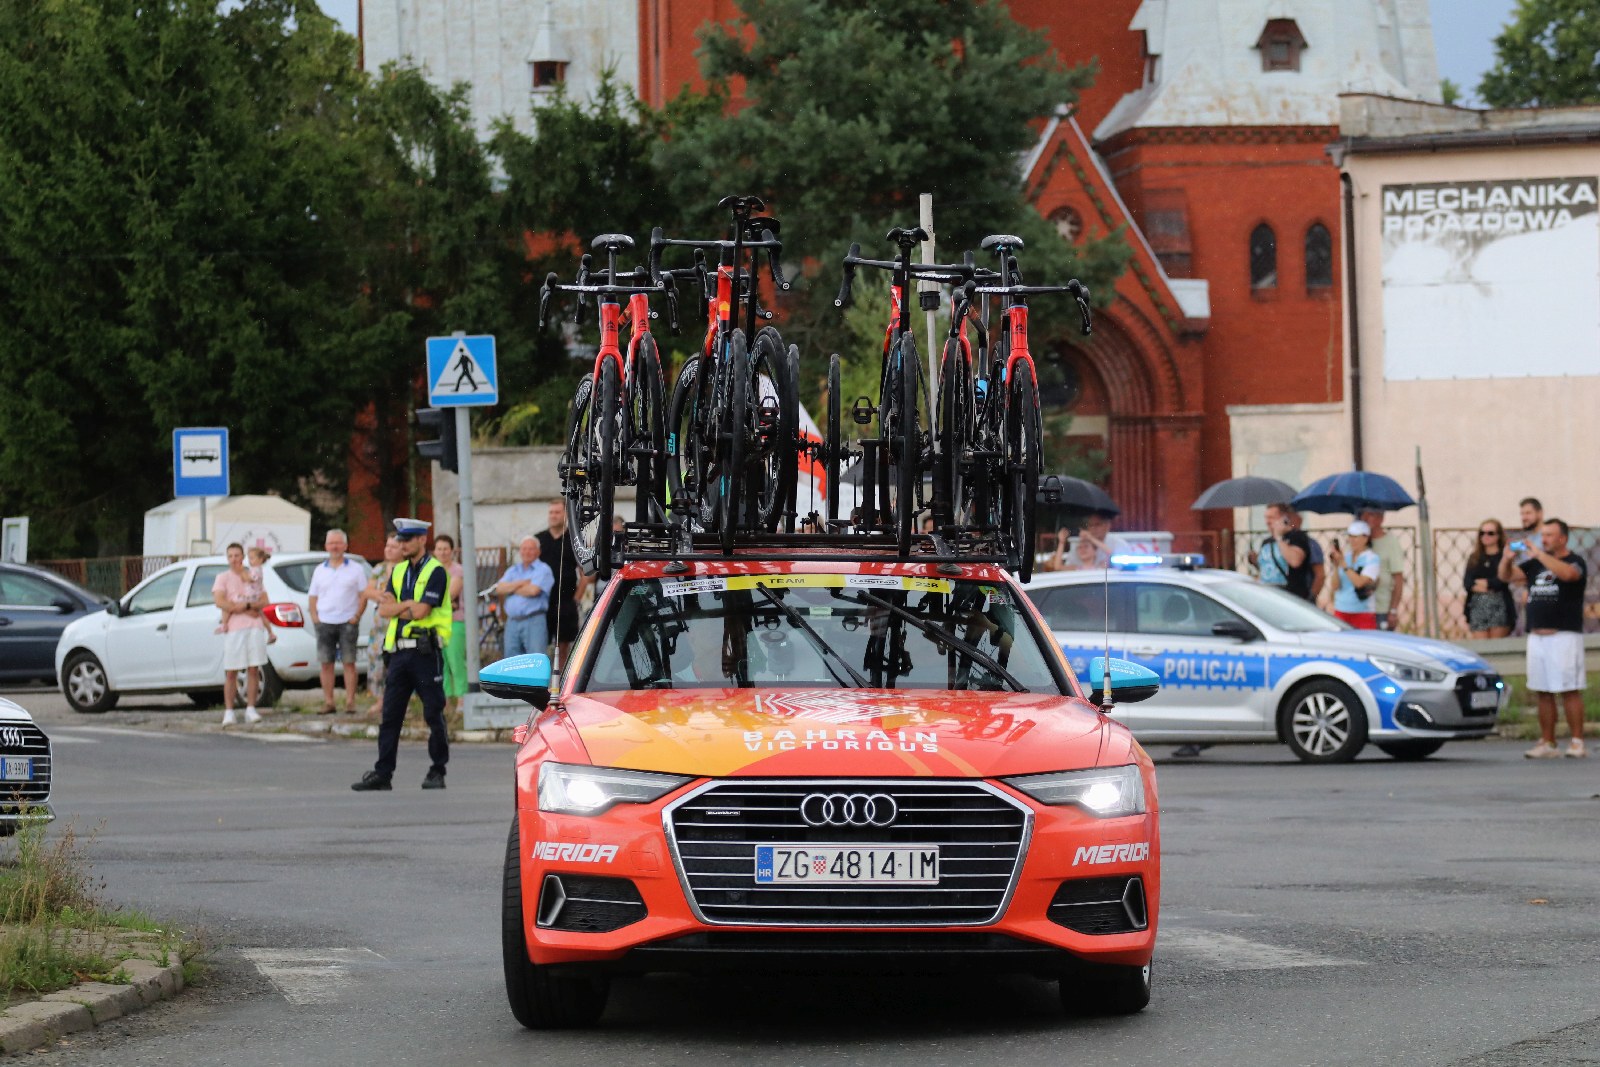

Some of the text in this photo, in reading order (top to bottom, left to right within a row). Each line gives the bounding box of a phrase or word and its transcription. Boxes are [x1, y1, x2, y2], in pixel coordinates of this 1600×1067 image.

[1383, 183, 1597, 213] MECHANIKA
[1384, 208, 1573, 234] POJAZDOWA
[1163, 658, 1247, 682] POLICJA
[743, 729, 938, 743] BAHRAIN
[744, 741, 939, 753] VICTORIOUS
[531, 841, 620, 863] MERIDA
[1071, 842, 1150, 867] MERIDA
[758, 868, 772, 878] HR
[777, 850, 809, 879] ZG
